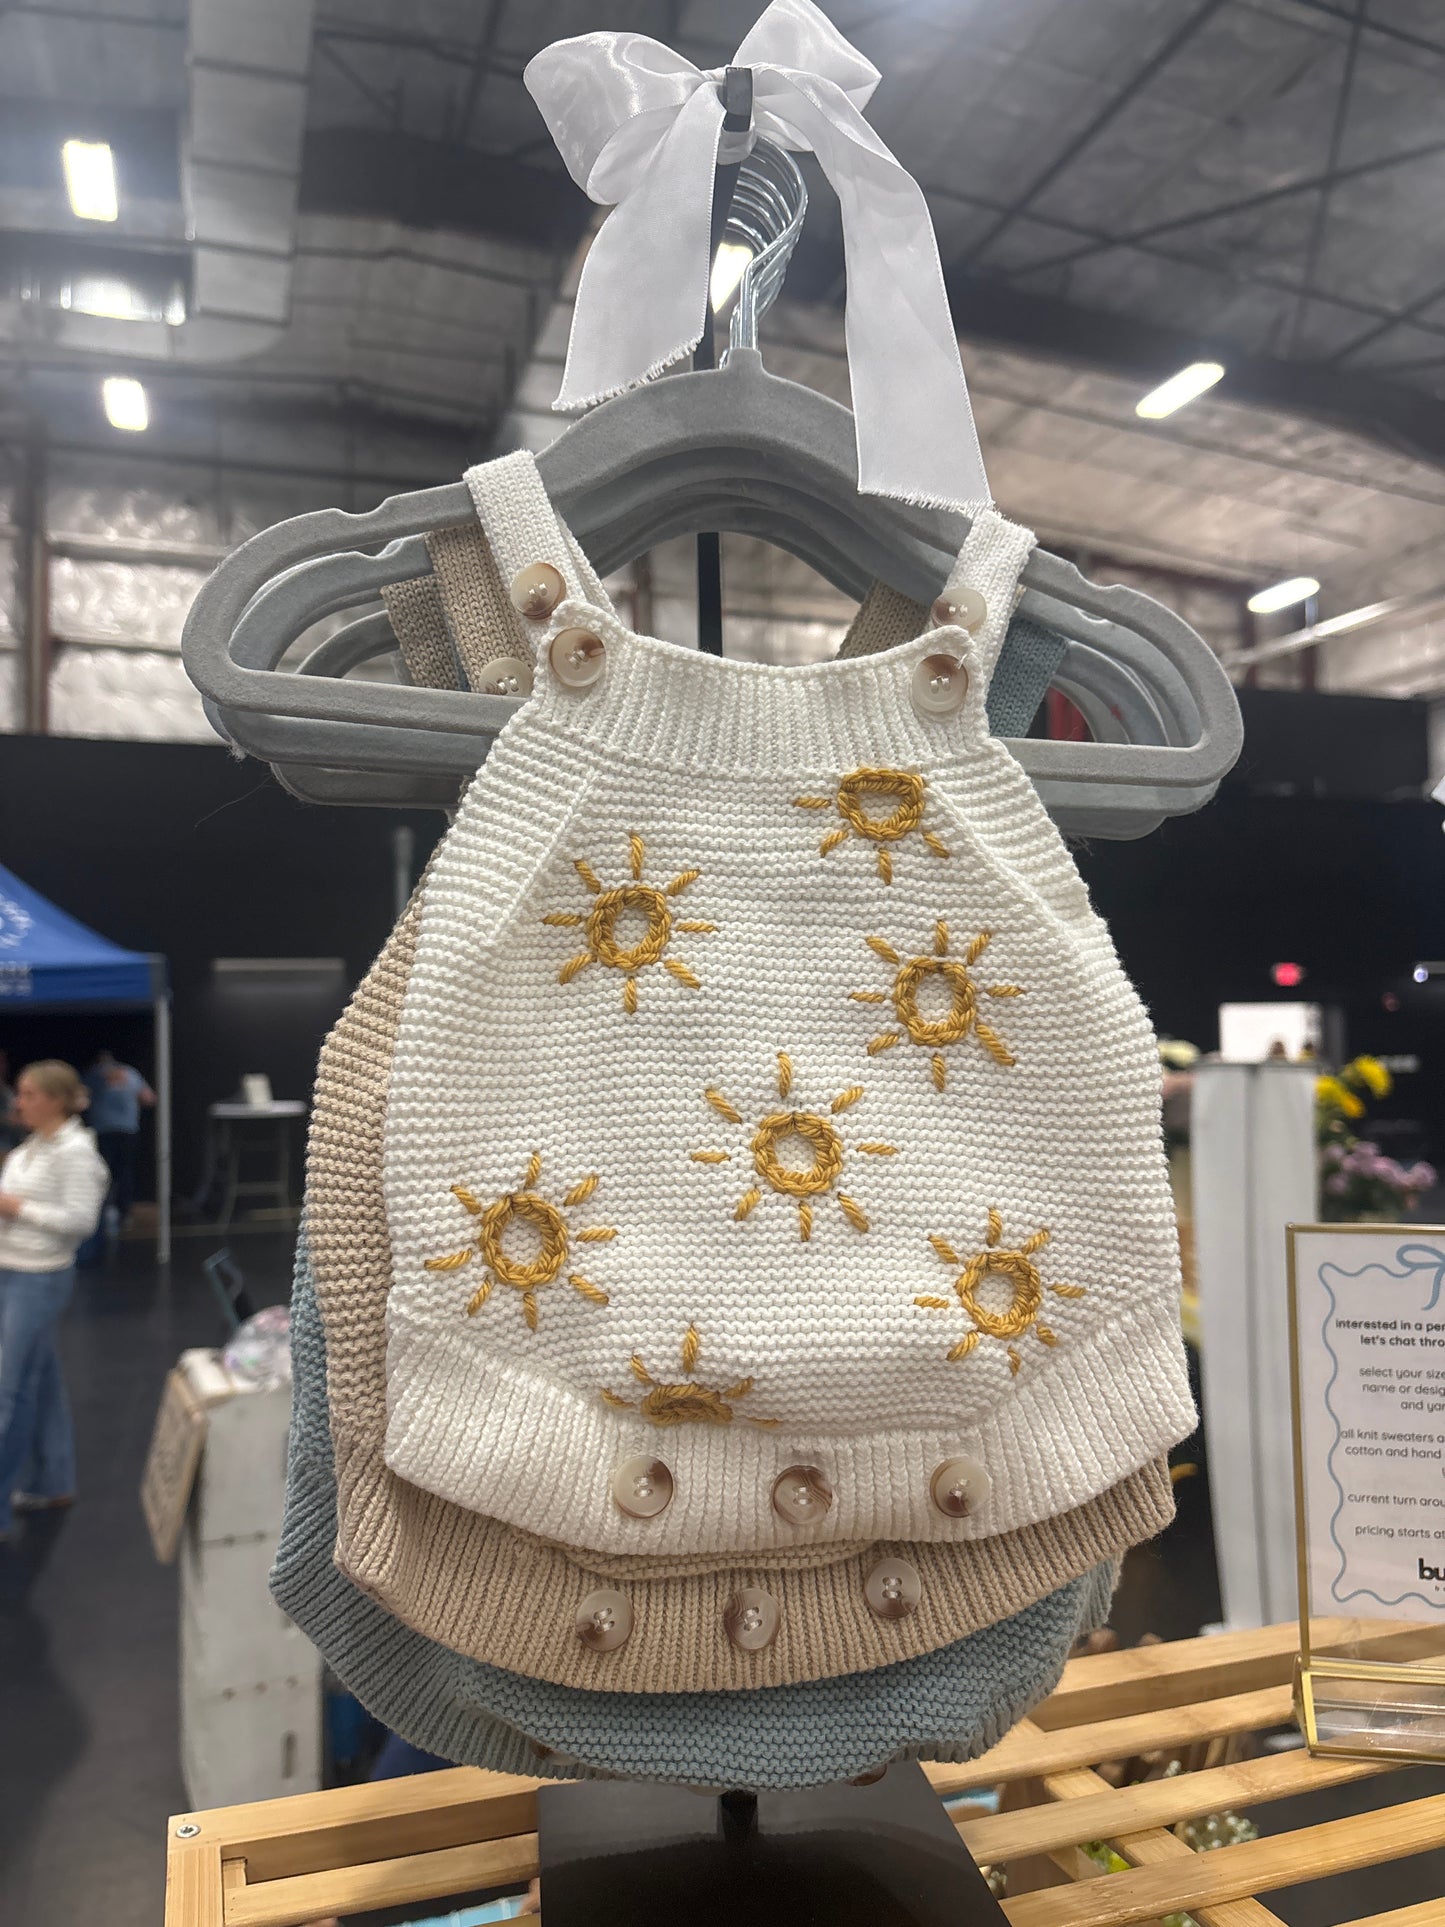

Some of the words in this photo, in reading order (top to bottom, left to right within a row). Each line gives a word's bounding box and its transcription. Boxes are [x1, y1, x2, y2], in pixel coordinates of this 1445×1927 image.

[1336, 1320, 1397, 1329] interested
[1400, 1320, 1411, 1330] in
[1414, 1322, 1422, 1331] a
[1360, 1335, 1386, 1345] let's
[1389, 1336, 1416, 1346] chat
[1420, 1337, 1445, 1347] thro
[1359, 1366, 1392, 1377] select
[1396, 1369, 1422, 1380] your
[1362, 1383, 1395, 1393] name
[1398, 1385, 1411, 1394] or
[1401, 1400, 1424, 1410] and
[1340, 1429, 1354, 1439] all
[1357, 1430, 1378, 1441] knit
[1381, 1432, 1434, 1443] sweaters
[1345, 1446, 1382, 1457] cotton
[1385, 1447, 1408, 1458] and
[1411, 1448, 1441, 1459] hand
[1347, 1494, 1390, 1504] current
[1393, 1495, 1416, 1505] turn
[1355, 1525, 1394, 1538] pricing
[1397, 1528, 1430, 1539] starts
